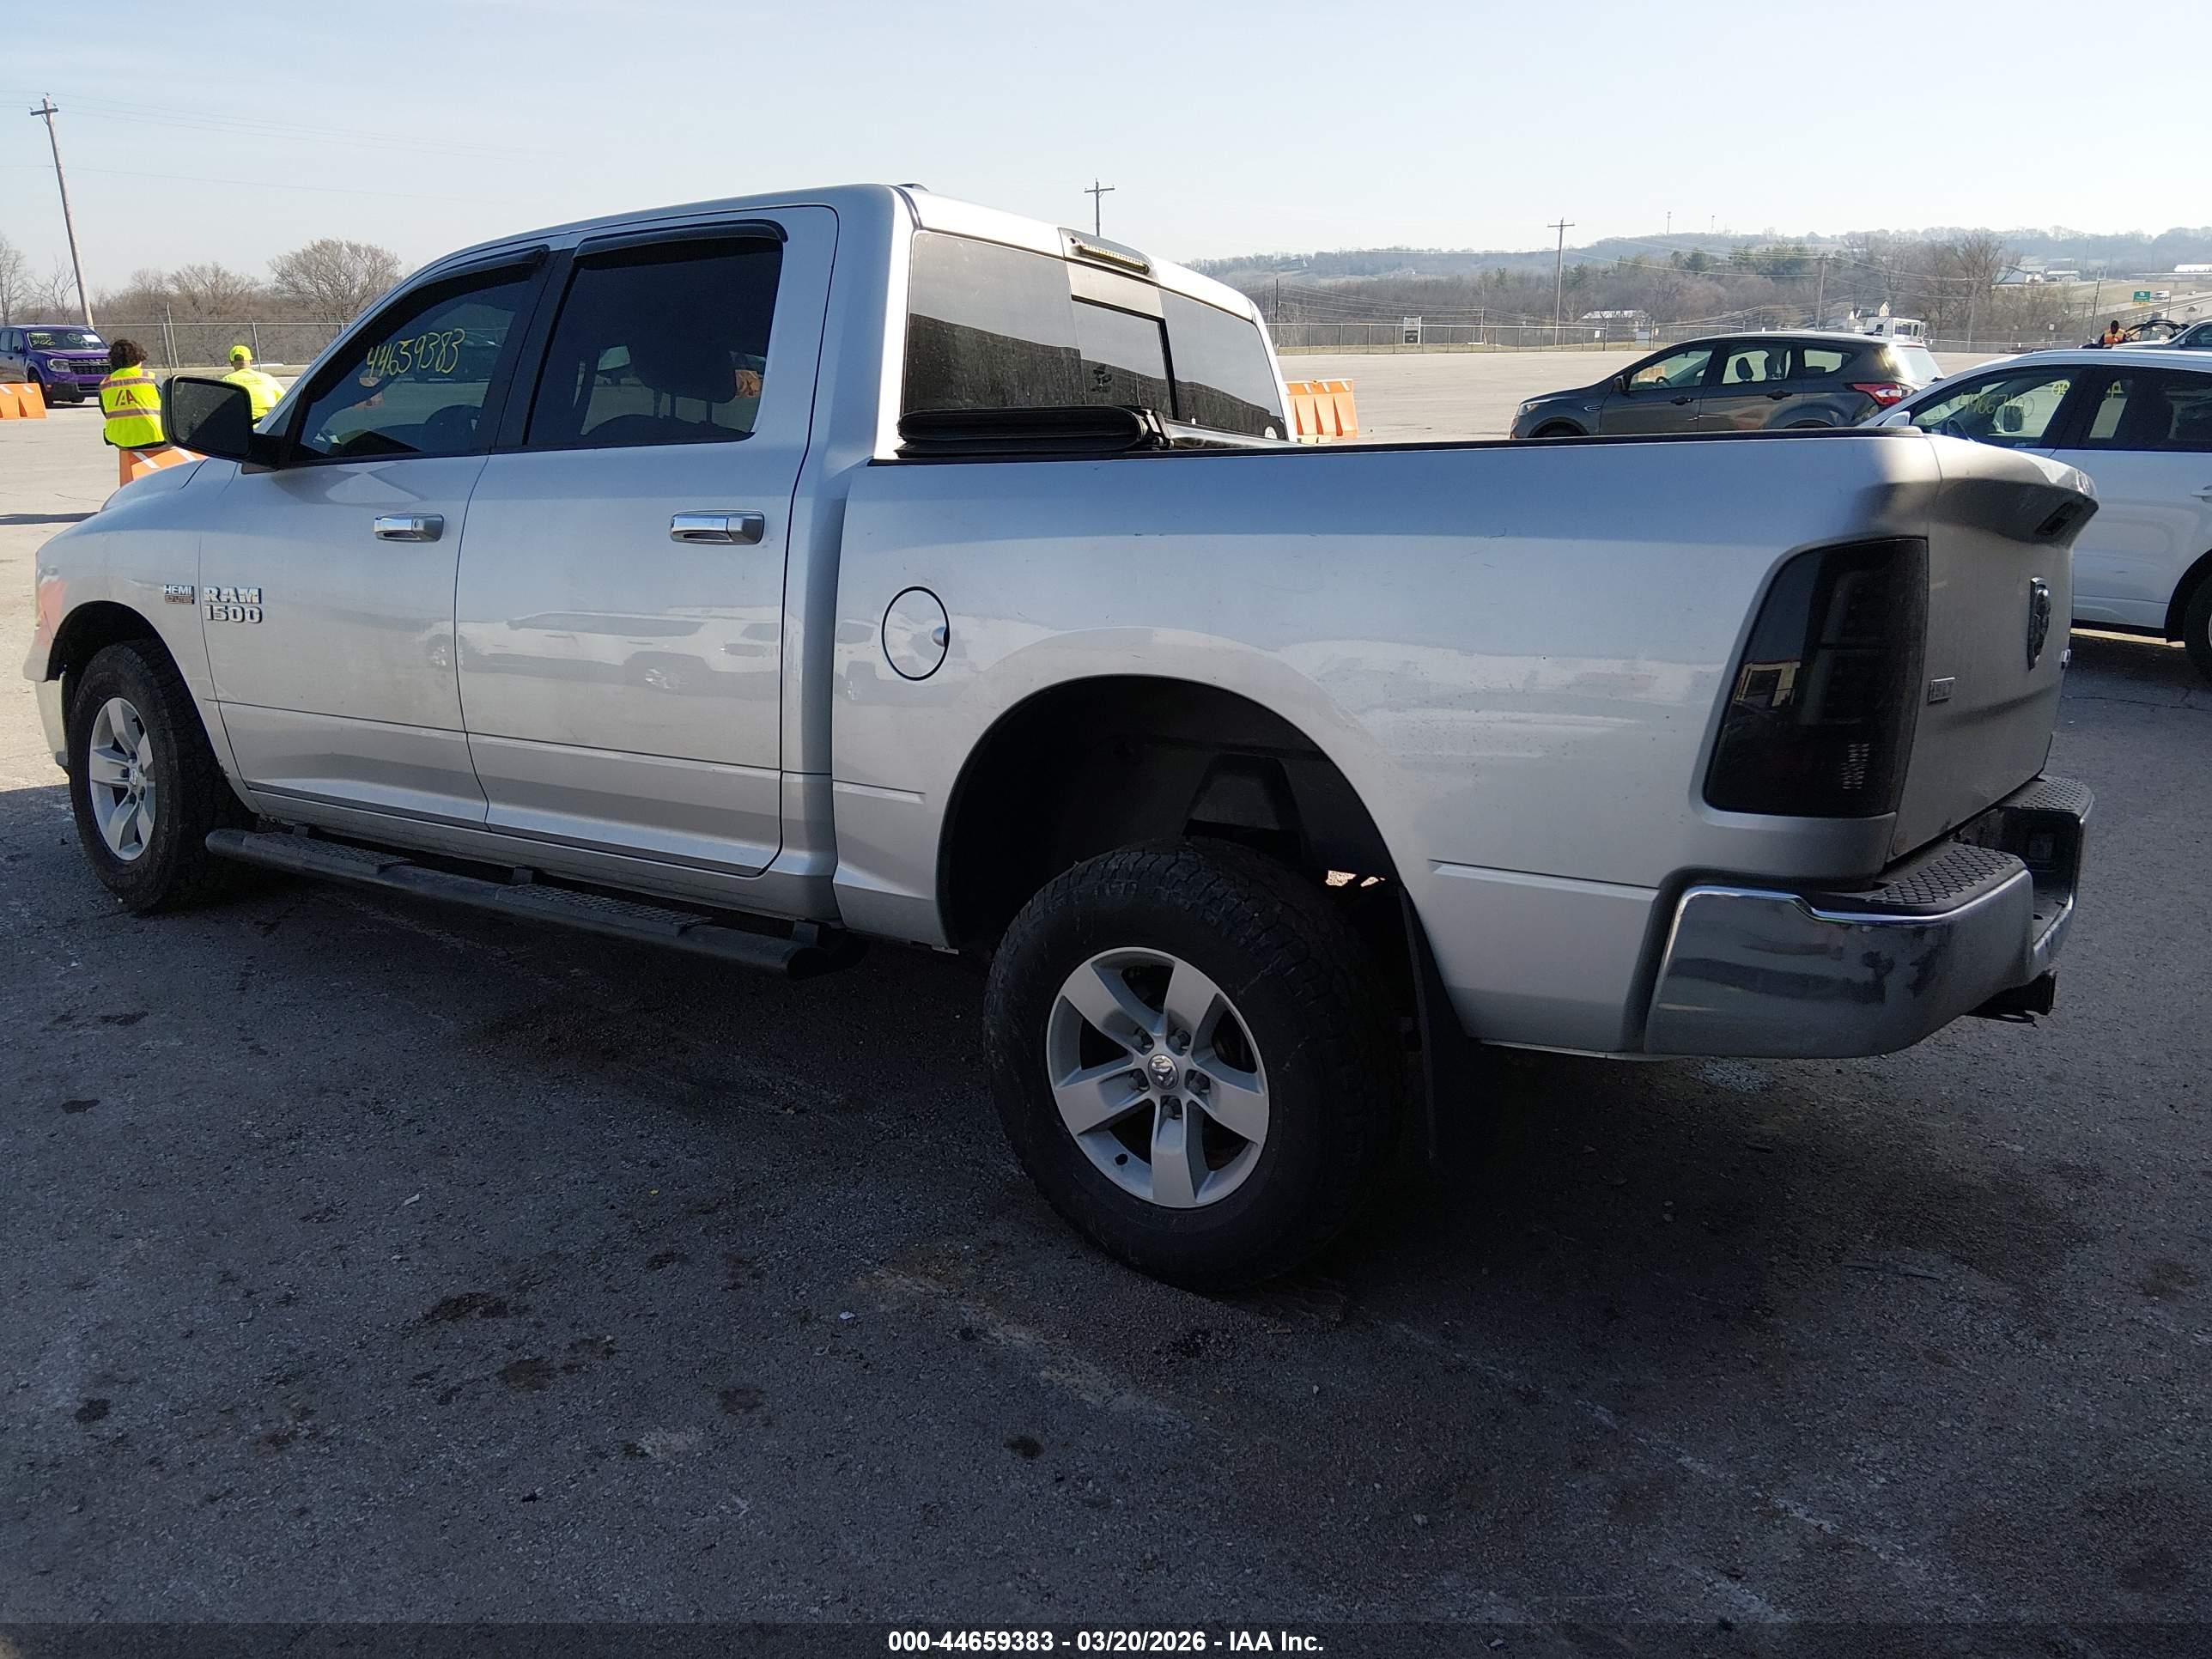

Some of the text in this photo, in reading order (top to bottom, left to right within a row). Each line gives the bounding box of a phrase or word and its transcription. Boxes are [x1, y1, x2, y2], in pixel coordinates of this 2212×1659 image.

[367, 328, 465, 378] 44659383
[164, 585, 192, 595] HEMI
[204, 586, 261, 604] RAM
[205, 605, 262, 623] 1500
